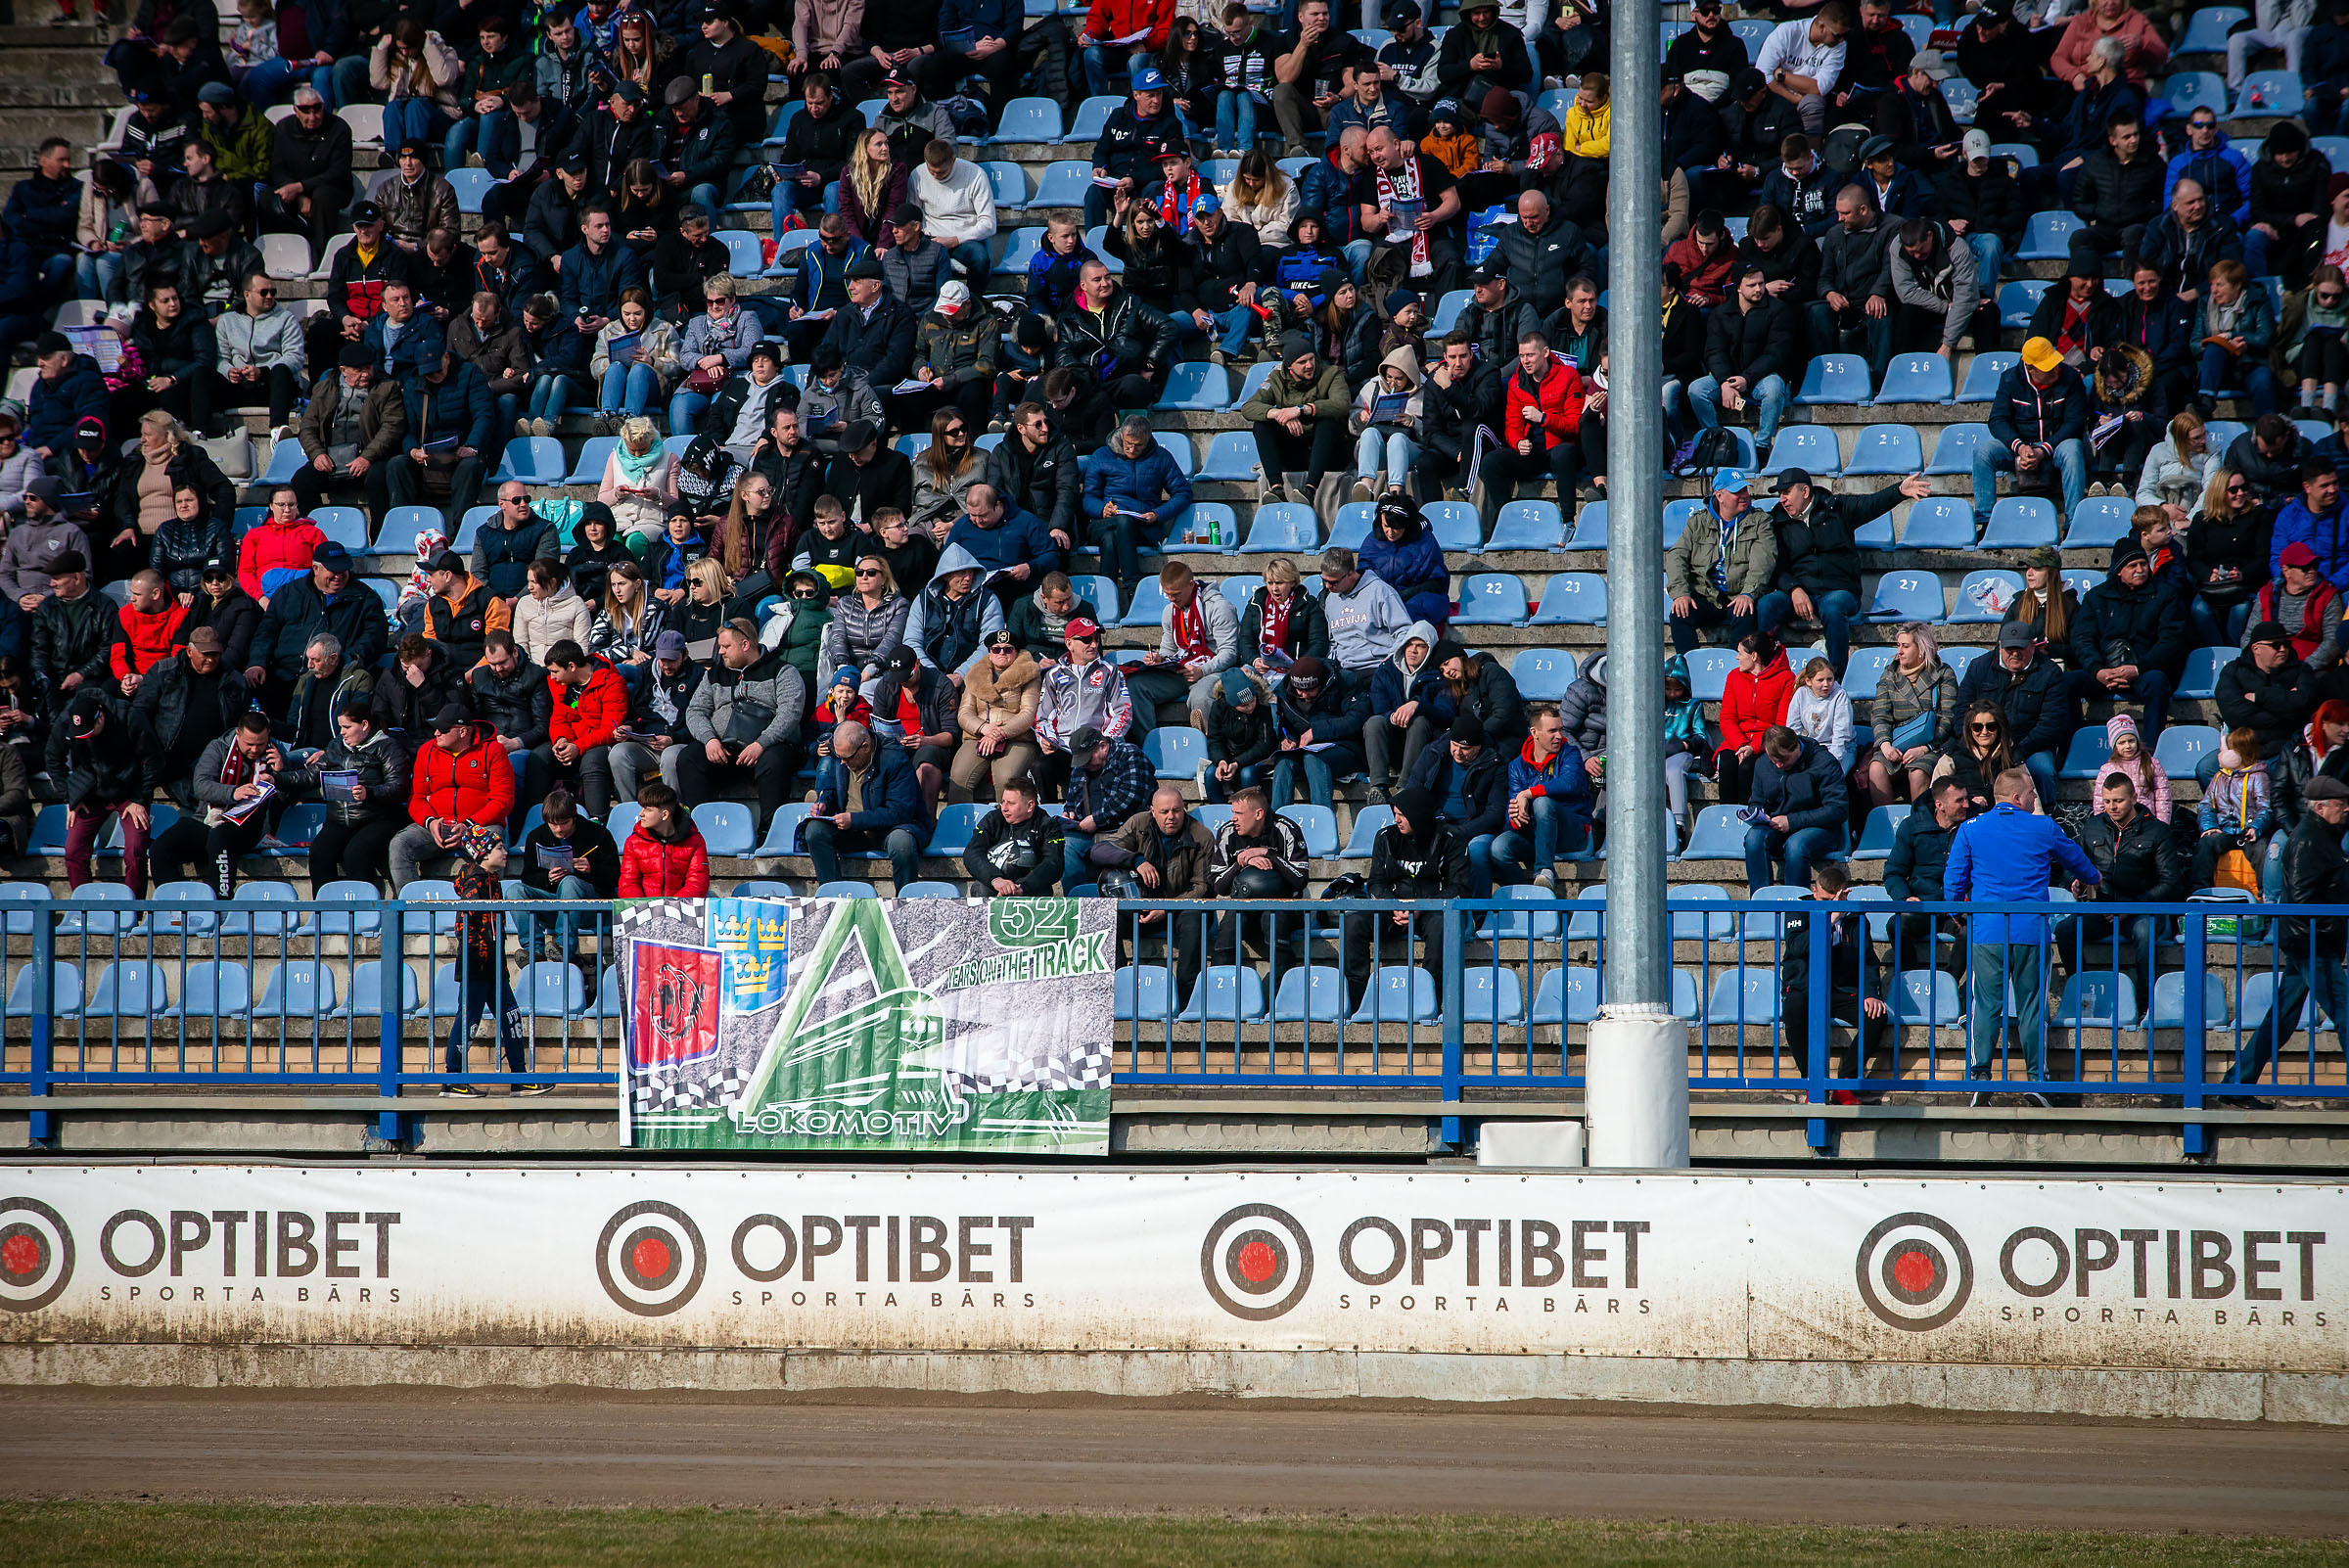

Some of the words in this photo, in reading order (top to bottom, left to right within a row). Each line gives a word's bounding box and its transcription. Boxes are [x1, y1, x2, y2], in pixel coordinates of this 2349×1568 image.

[1029, 109, 1042, 118] 13
[990, 171, 1002, 181] 13
[1805, 191, 1822, 204] CAMP
[727, 240, 741, 251] 10
[1290, 281, 1309, 291] NIKE
[1825, 361, 1844, 374] 25
[1911, 361, 1930, 374] 26
[1796, 435, 1816, 447] 25
[1878, 434, 1899, 447] 26
[1276, 510, 1291, 523] 19
[1444, 508, 1459, 521] 21
[1522, 507, 1540, 522] 22
[1933, 505, 1950, 518] 27
[2101, 504, 2120, 518] 29
[333, 513, 340, 524] 7
[1081, 583, 1096, 597] 17
[1485, 582, 1502, 595] 22
[1564, 579, 1581, 594] 23
[1901, 578, 1918, 591] 27
[1330, 612, 1367, 629] LATVIJA
[1535, 658, 1553, 671] 23
[1705, 658, 1724, 672] 25
[1790, 658, 1807, 670] 26
[1173, 737, 1188, 751] 19
[2186, 737, 2199, 749] 31
[21, 890, 27, 899] 6
[999, 897, 1068, 939] 52
[947, 961, 977, 989] YEARS
[979, 957, 997, 985] ON
[999, 950, 1029, 981] THE
[1032, 932, 1106, 979] TRACK
[129, 970, 137, 981] 8
[294, 972, 310, 984] 10
[546, 975, 561, 987] 13
[1217, 977, 1236, 989] 21
[1391, 977, 1406, 989] 23
[2090, 984, 2105, 995] 31
[735, 1109, 960, 1136] LOKOMOTIV
[100, 1210, 400, 1277] OPTIBET
[731, 1214, 1034, 1282] OPTIBET
[1339, 1217, 1650, 1288] OPTIBET
[2000, 1226, 2326, 1301] OPTIBET
[102, 1286, 264, 1302] SPORTA
[299, 1283, 400, 1303] BĀRS
[733, 1291, 897, 1307] SPORTA
[932, 1288, 1035, 1308] BĀRS
[1341, 1295, 1508, 1312] SPORTA
[1544, 1294, 1650, 1314] BĀRS
[2002, 1307, 2180, 1325] SPORTA
[2216, 1306, 2326, 1327] BĀRS
